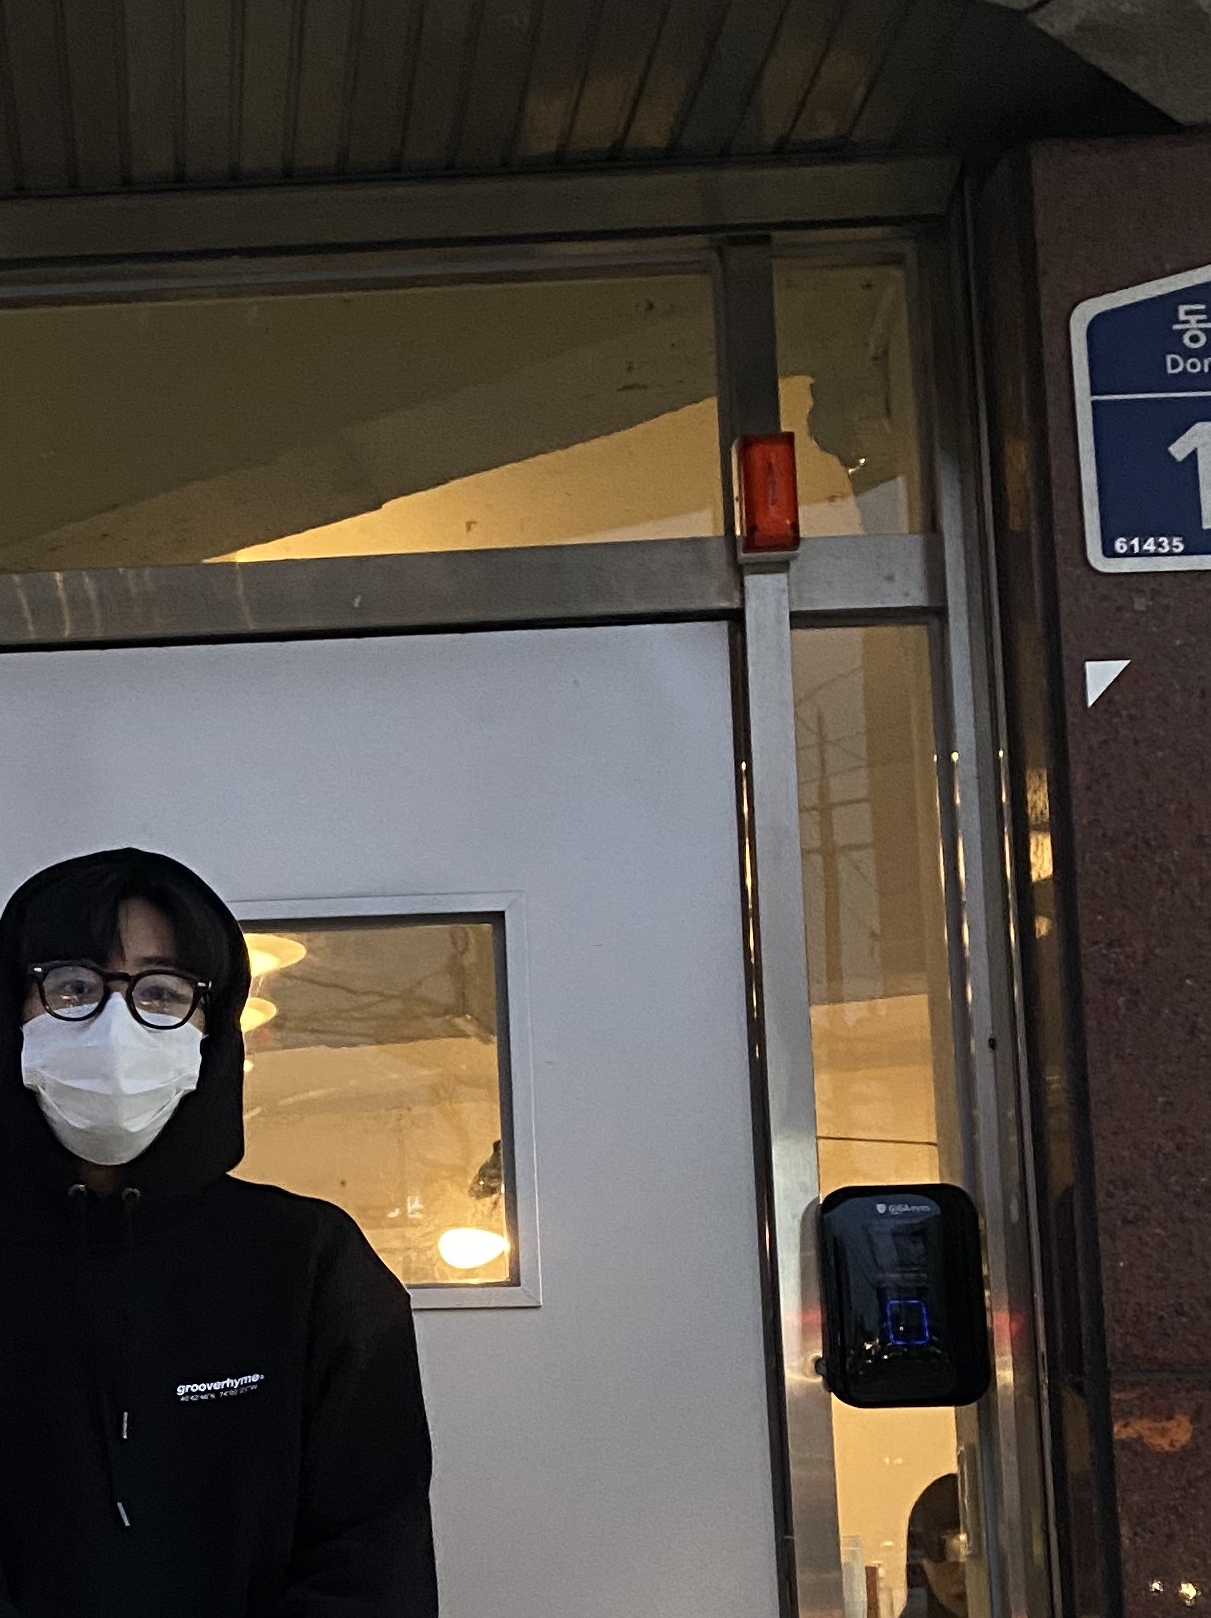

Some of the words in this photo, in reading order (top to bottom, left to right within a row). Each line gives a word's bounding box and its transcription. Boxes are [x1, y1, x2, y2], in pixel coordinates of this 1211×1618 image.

[1172, 303, 1211, 349] 동
[1167, 421, 1211, 530] 1
[1114, 536, 1185, 554] 61435
